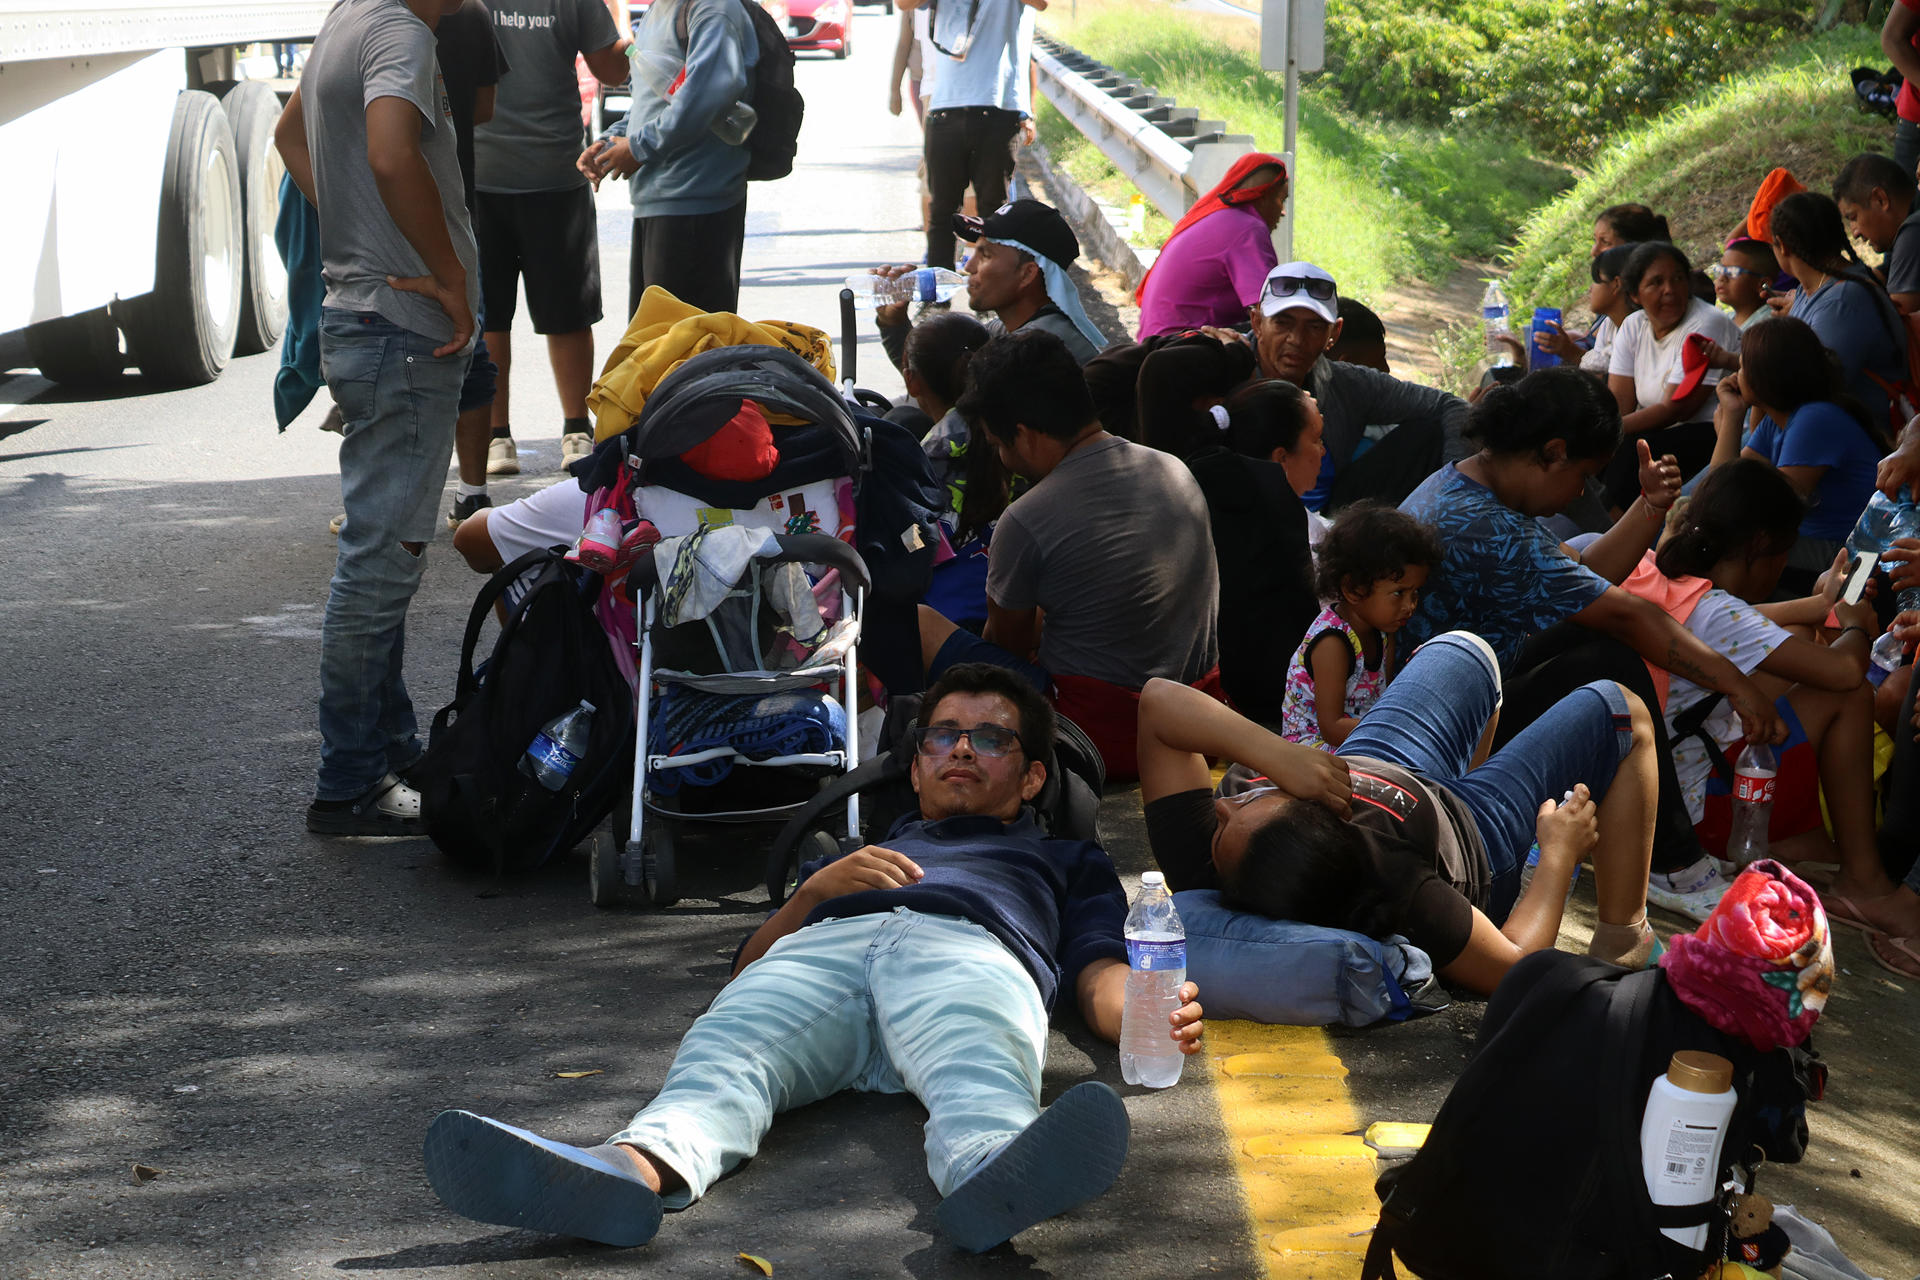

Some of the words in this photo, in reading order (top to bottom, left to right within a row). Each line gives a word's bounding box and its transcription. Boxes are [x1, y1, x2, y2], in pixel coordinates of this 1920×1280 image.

[493, 10, 498, 26] I
[500, 10, 526, 29] help
[528, 15, 555, 30] you?
